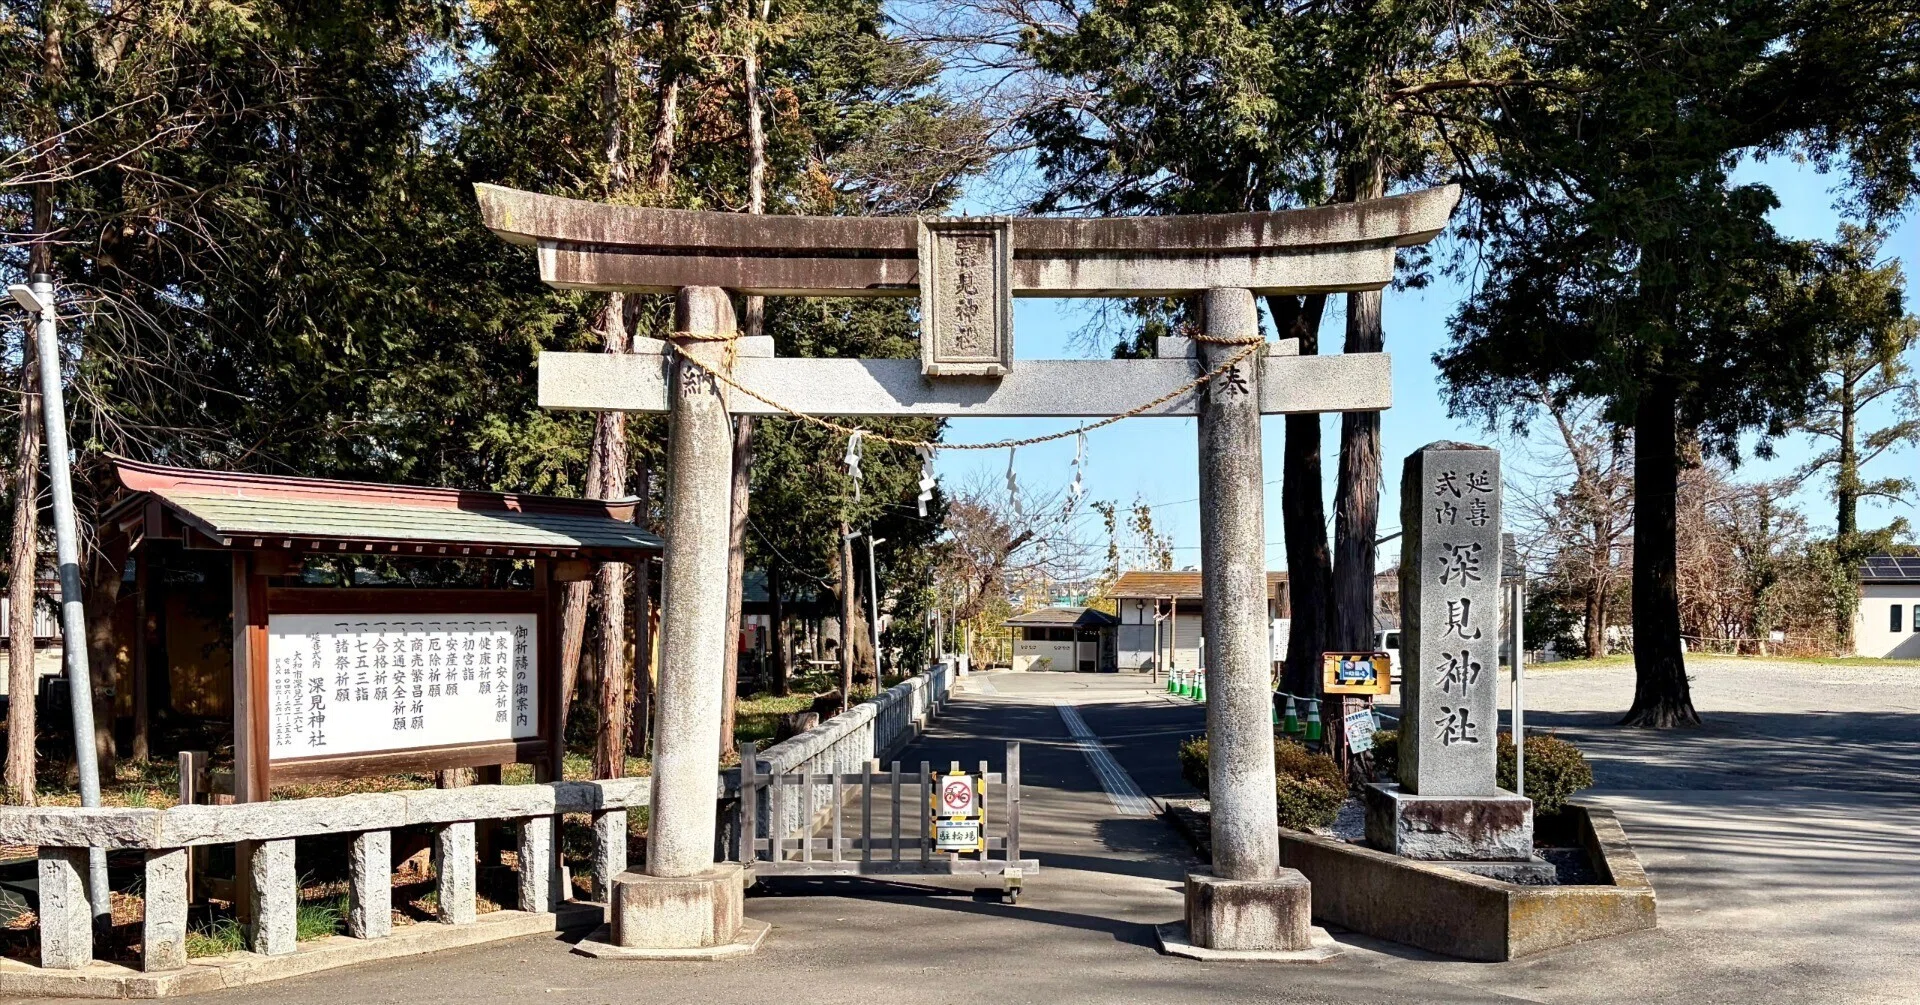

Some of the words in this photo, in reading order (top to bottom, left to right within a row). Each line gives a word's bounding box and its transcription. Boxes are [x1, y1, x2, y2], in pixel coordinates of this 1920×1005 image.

[1217, 364, 1248, 399] 奉
[1434, 471, 1461, 525] 式内
[1466, 470, 1493, 526] 延喜
[1434, 542, 1482, 746] 深見神社
[308, 677, 327, 747] 深見神社
[940, 831, 976, 842] 駐輪場
